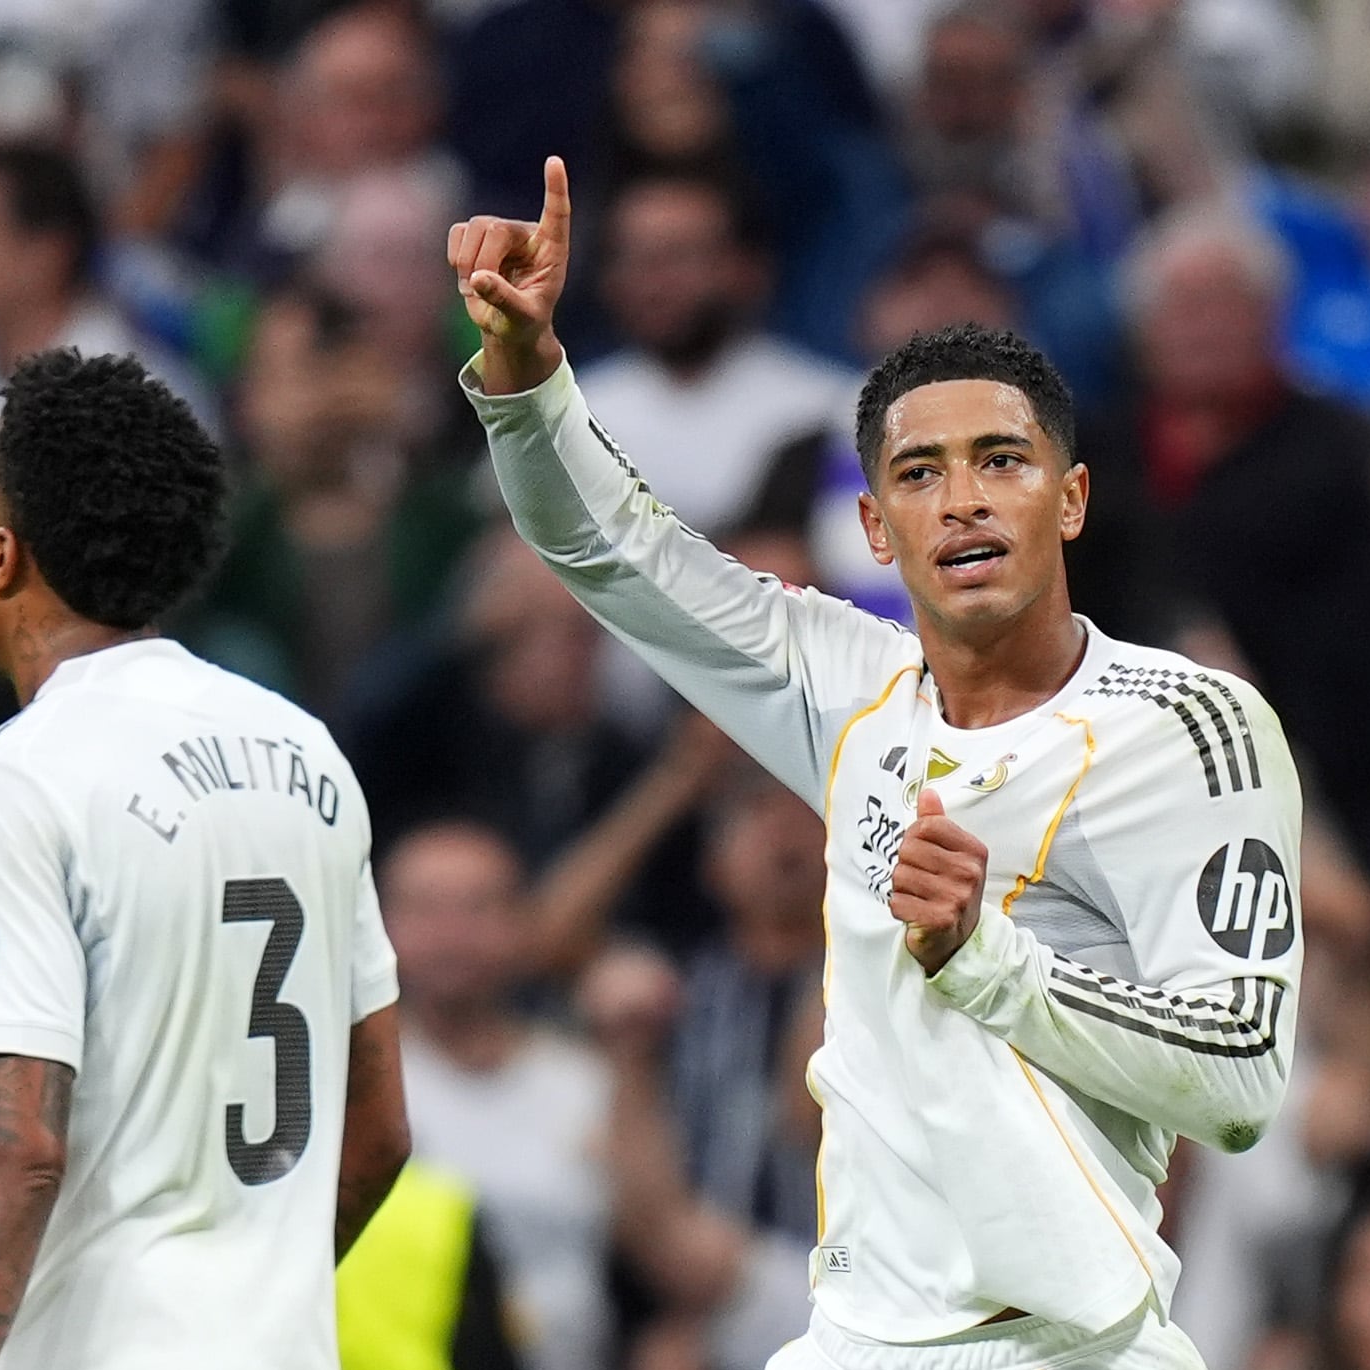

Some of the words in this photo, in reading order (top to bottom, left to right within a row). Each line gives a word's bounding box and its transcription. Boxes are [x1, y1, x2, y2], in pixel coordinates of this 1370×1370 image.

[127, 793, 187, 845] E.
[161, 736, 339, 828] MILITÃO
[1205, 838, 1292, 960] hp
[222, 877, 312, 1186] 3
